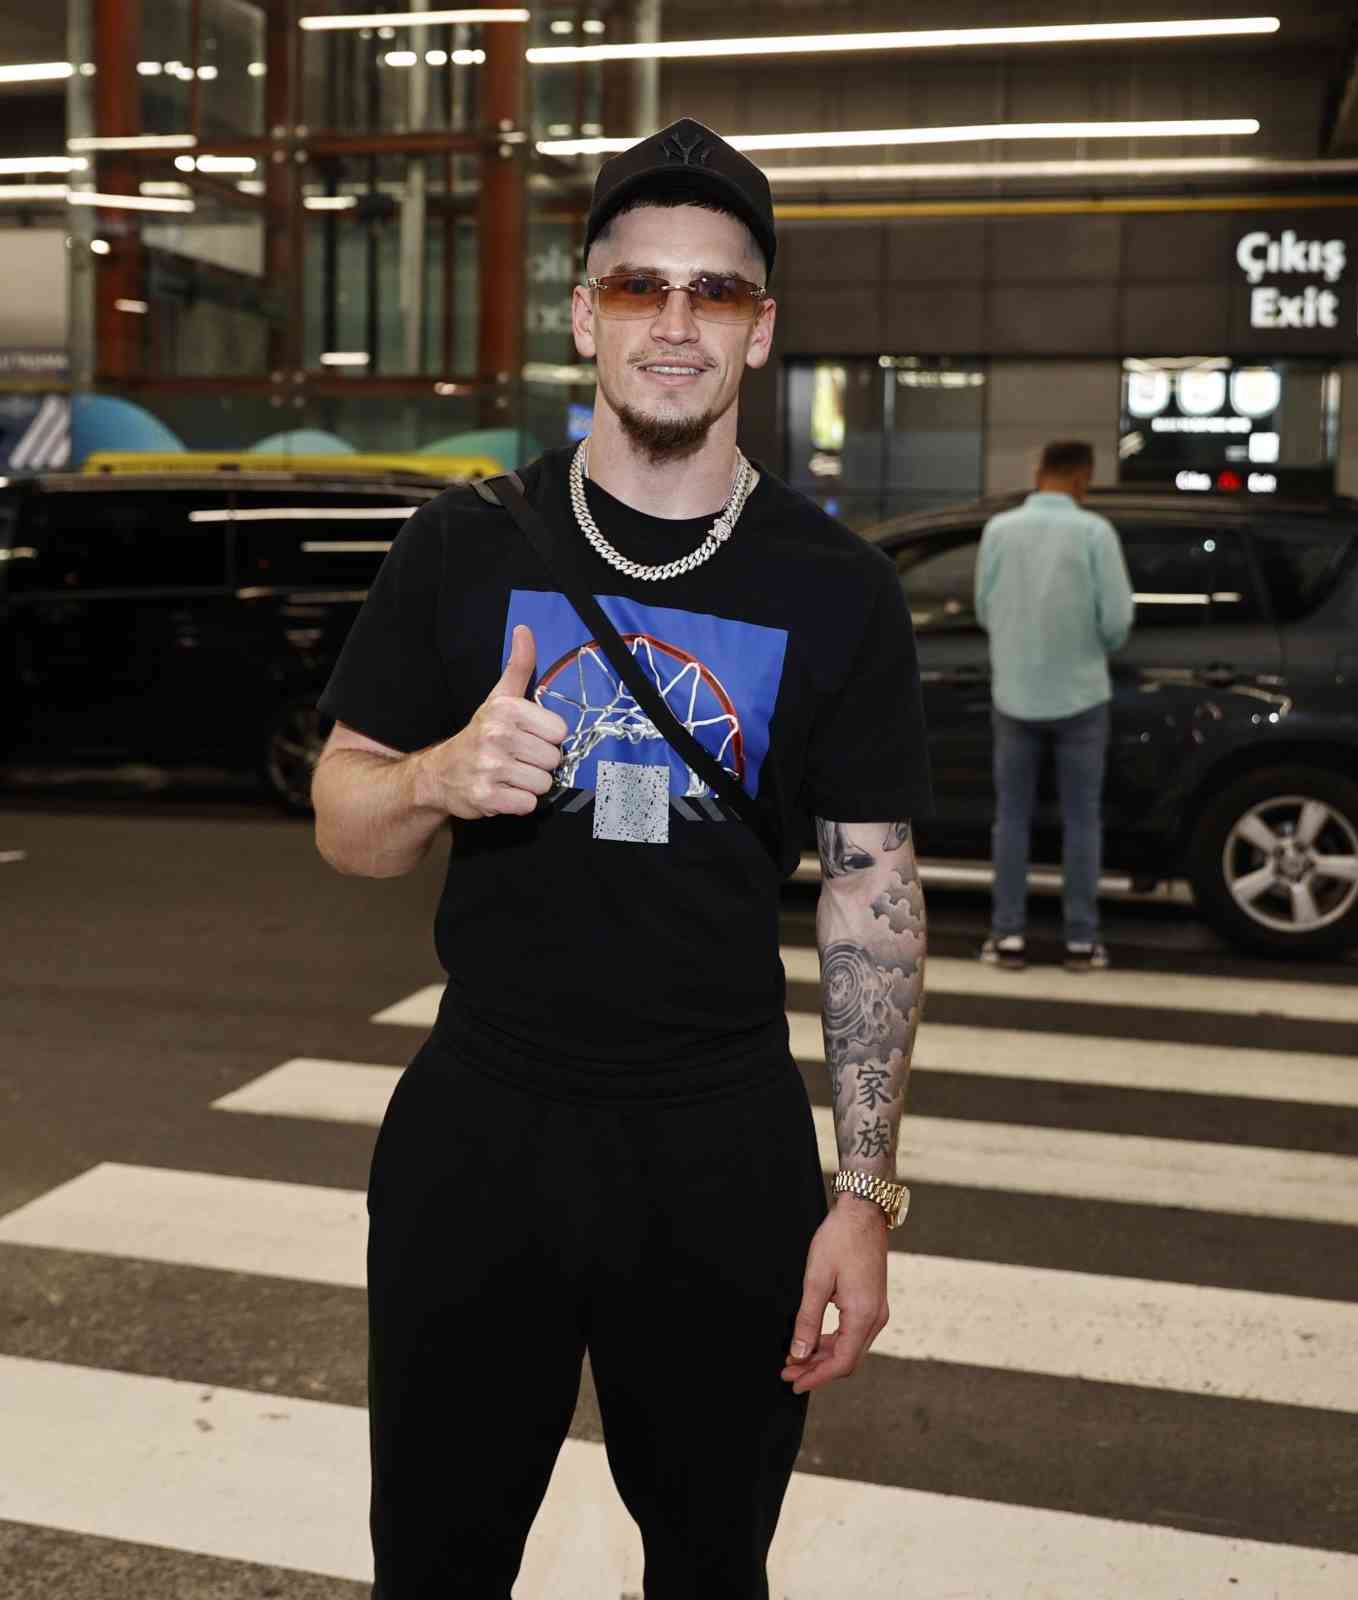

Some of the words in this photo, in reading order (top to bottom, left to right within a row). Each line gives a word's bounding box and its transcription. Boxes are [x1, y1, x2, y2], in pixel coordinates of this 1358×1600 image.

[1236, 229, 1347, 284] Çıkış
[1250, 285, 1339, 328] Exit
[855, 1063, 892, 1158] 家族
